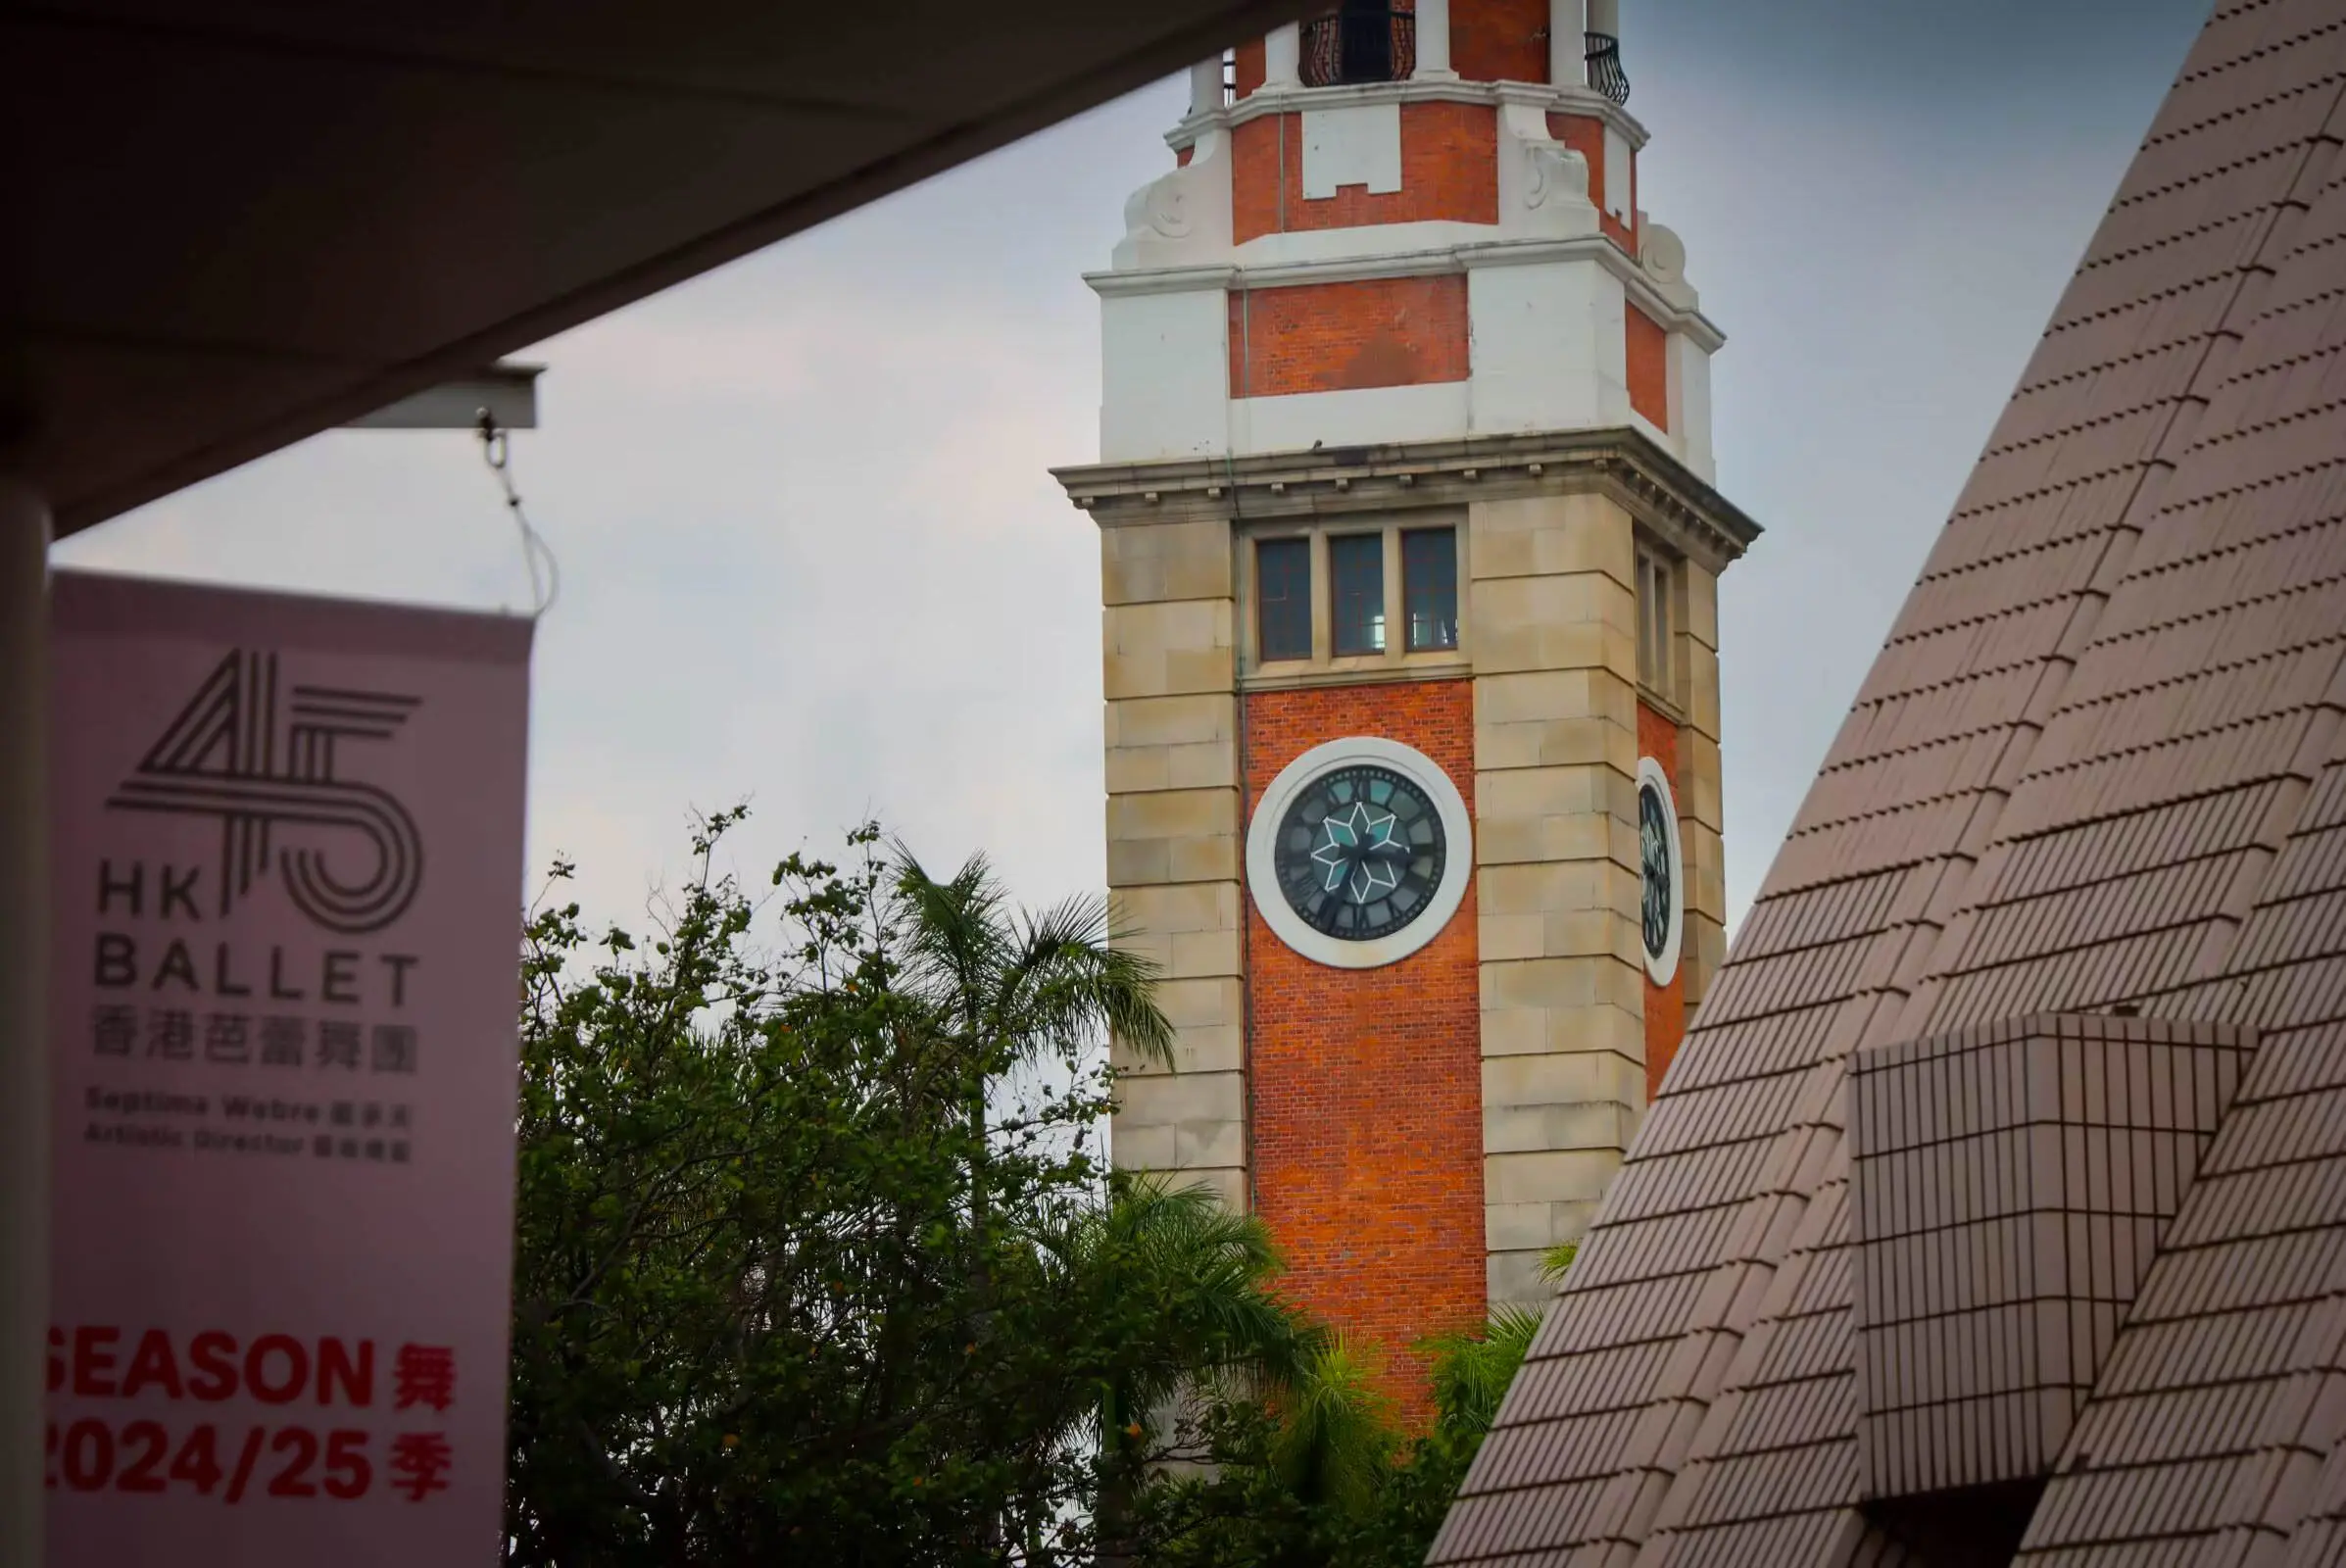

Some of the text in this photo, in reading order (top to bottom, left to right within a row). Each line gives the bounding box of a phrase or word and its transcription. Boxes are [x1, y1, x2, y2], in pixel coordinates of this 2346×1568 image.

[104, 645, 425, 936] 45
[97, 857, 202, 923] HK
[92, 931, 419, 1008] BALLET
[46, 1417, 372, 1505] 024/25
